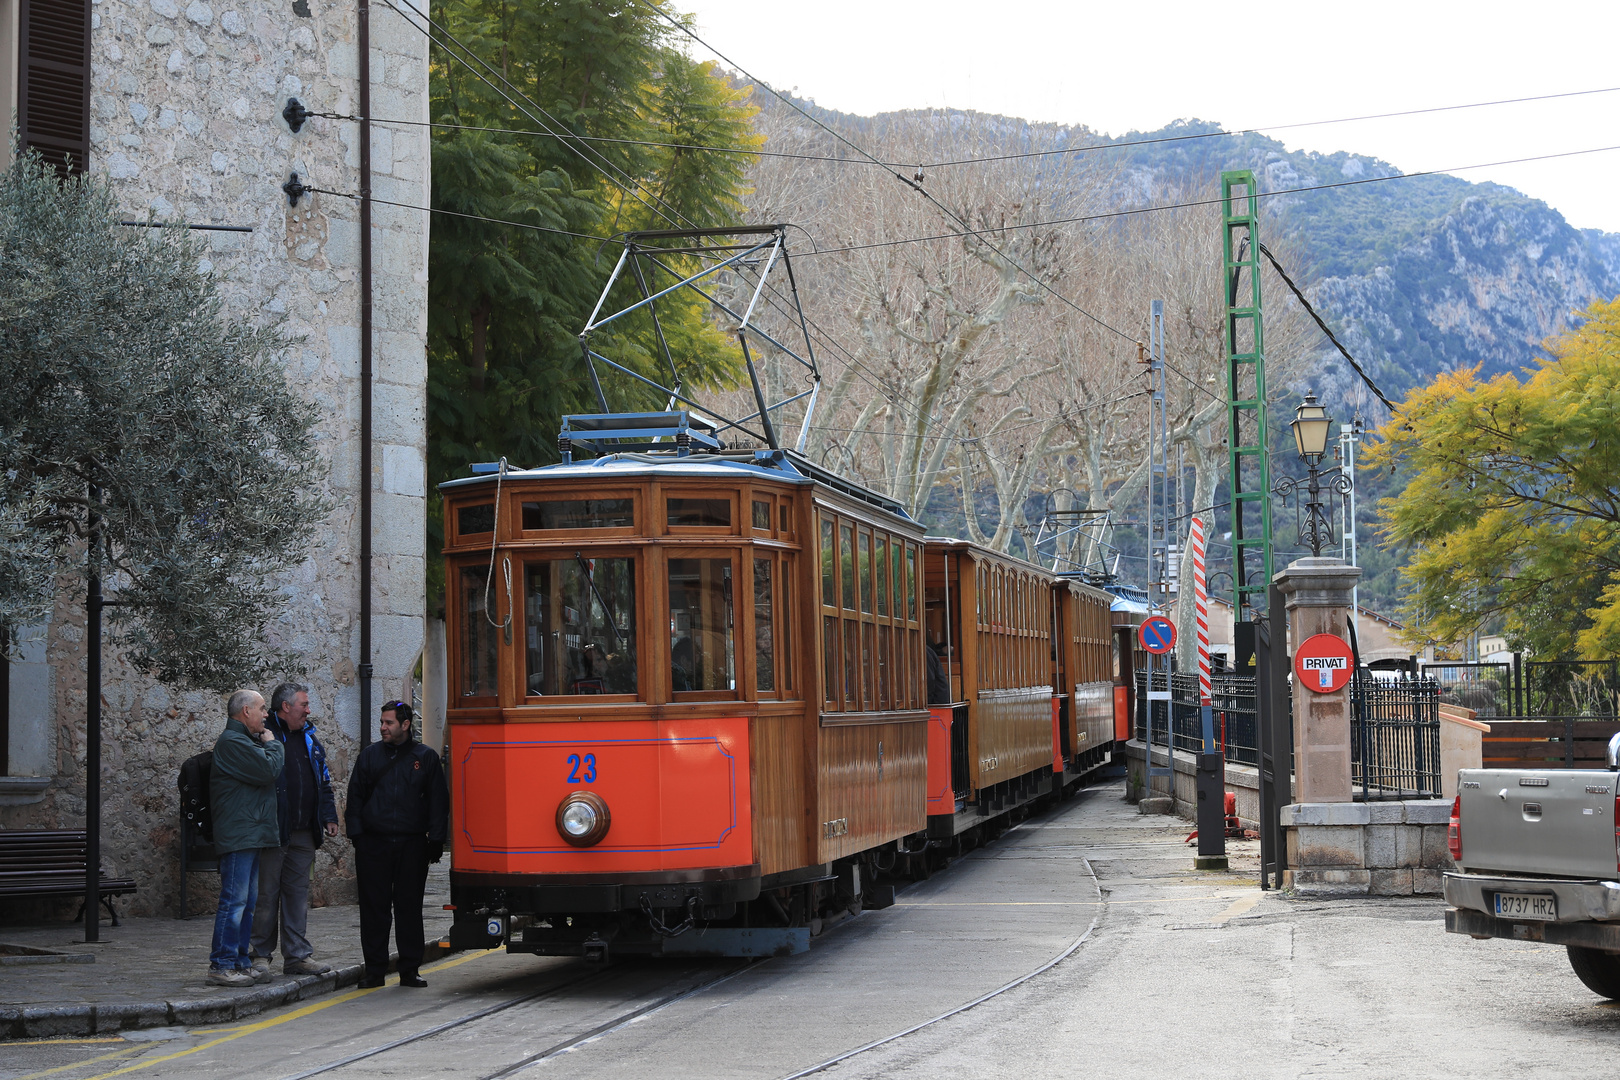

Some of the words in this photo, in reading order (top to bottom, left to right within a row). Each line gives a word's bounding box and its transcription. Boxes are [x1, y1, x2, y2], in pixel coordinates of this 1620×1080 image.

[1306, 658, 1344, 669] PRIVAT
[567, 753, 597, 783] 23
[1585, 785, 1611, 794] HILUX
[1502, 896, 1529, 913] 8737
[1533, 898, 1554, 915] HRZ
